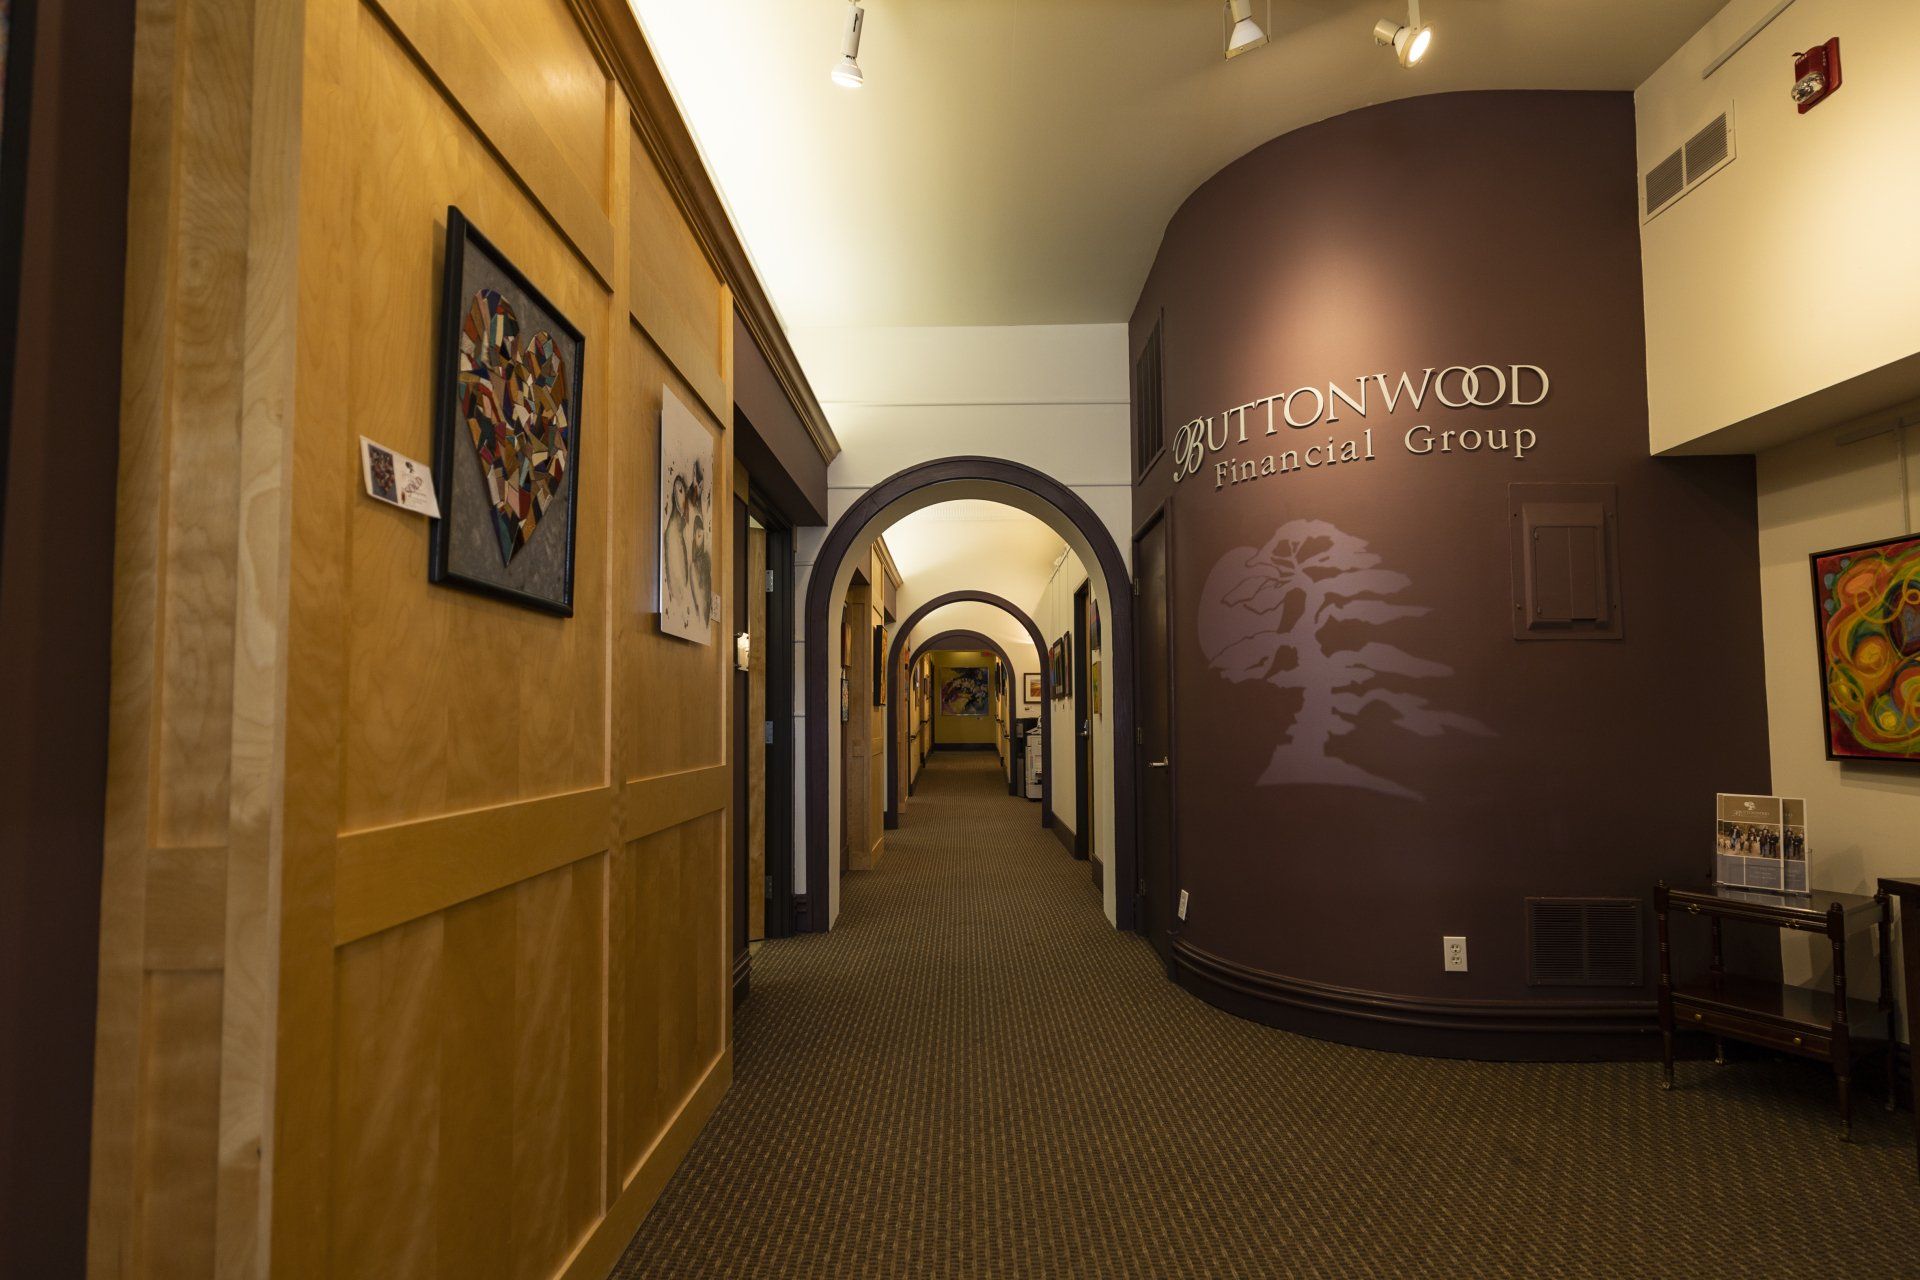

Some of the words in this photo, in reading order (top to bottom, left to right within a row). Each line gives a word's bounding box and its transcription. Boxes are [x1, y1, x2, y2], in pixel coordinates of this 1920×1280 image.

[1172, 363, 1551, 483] BUTTONWOOD
[1213, 428, 1376, 490] Financial
[1404, 424, 1537, 459] Group
